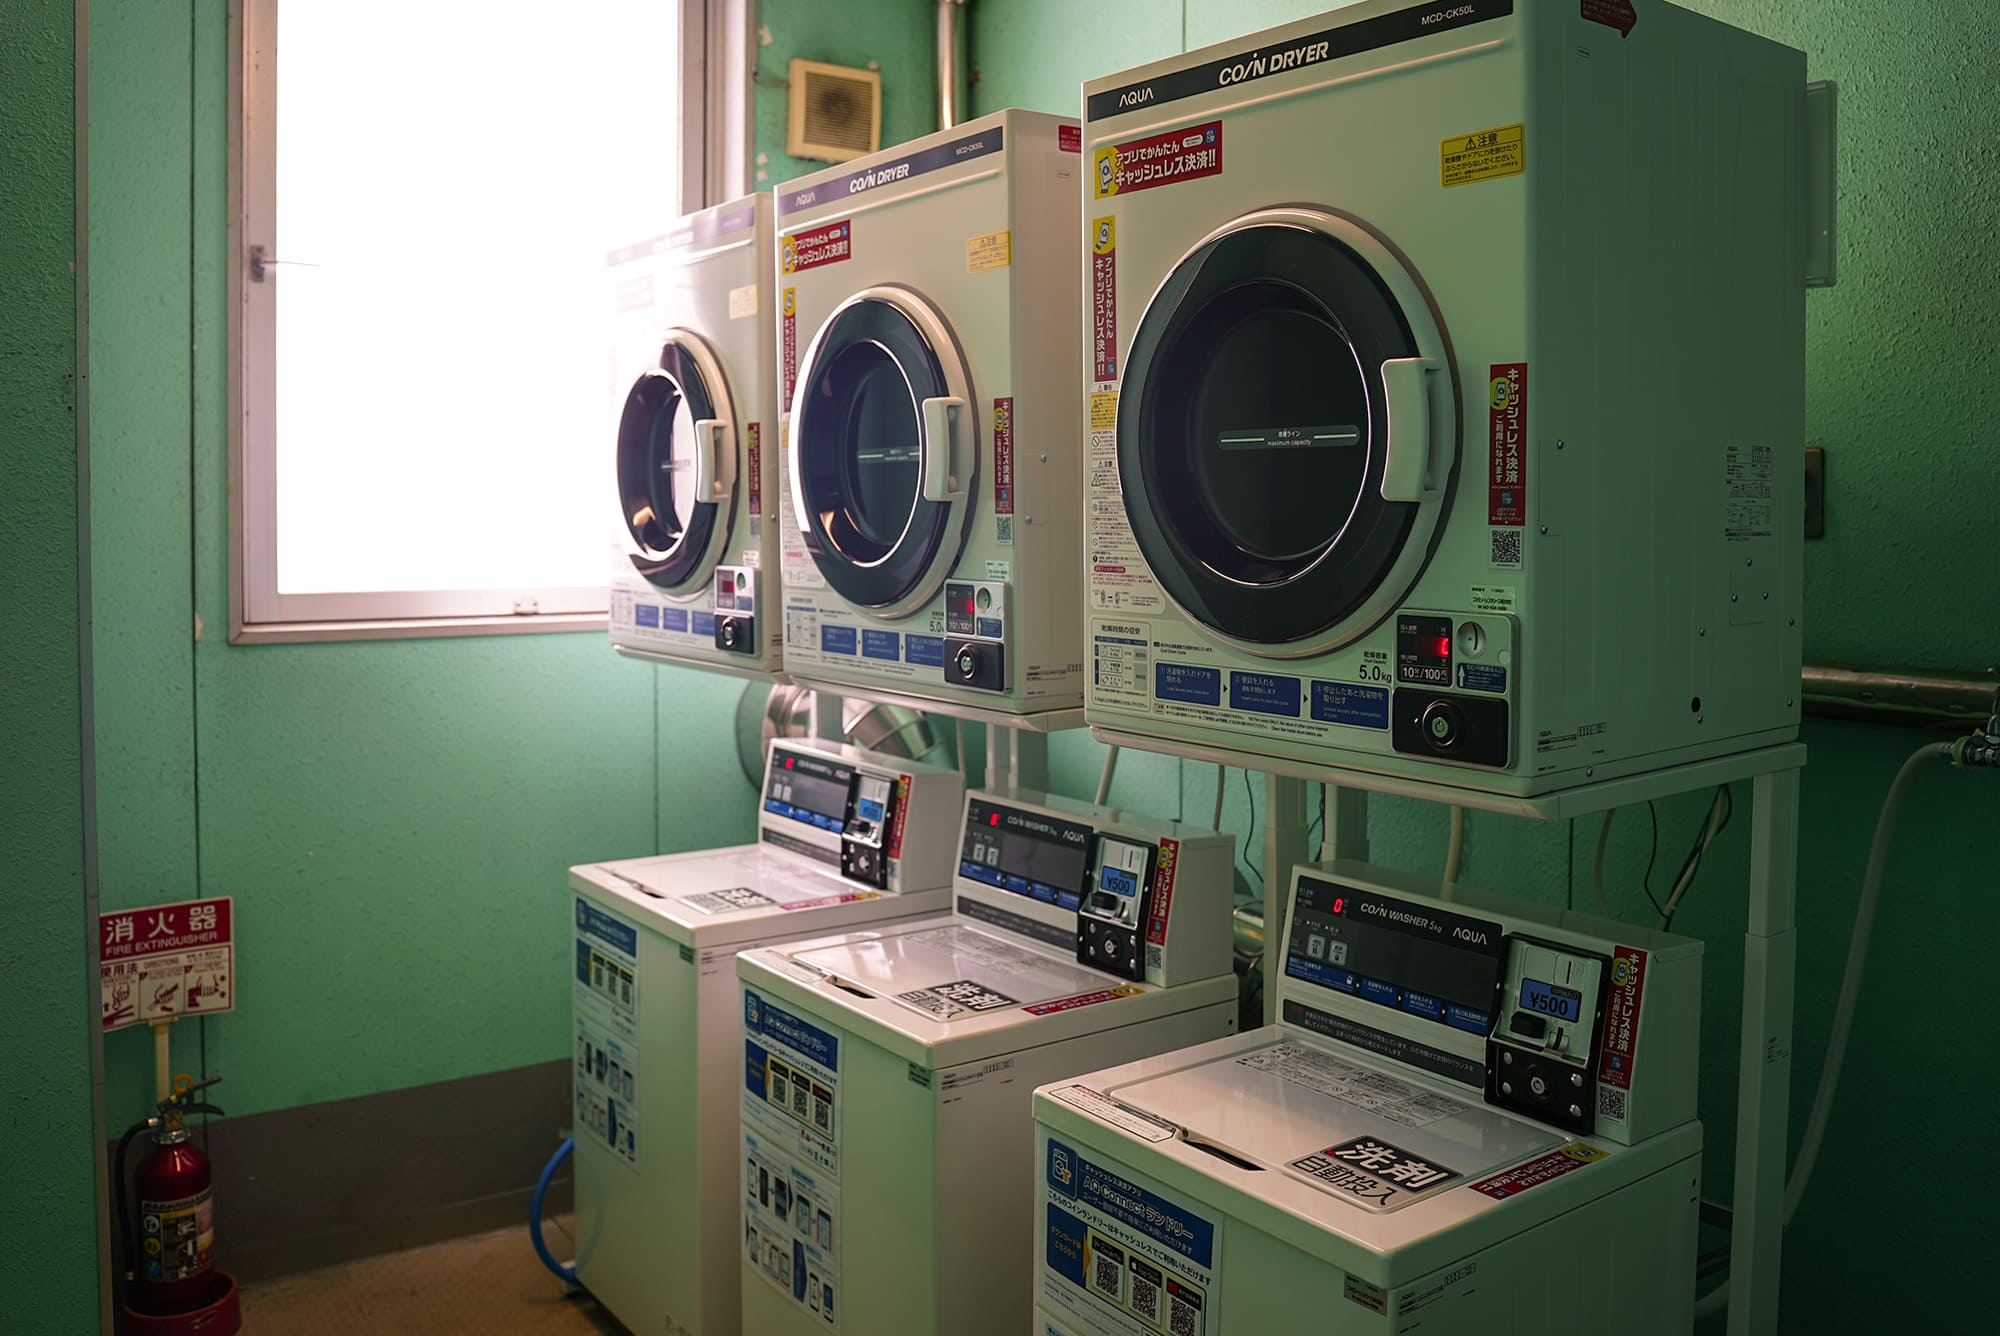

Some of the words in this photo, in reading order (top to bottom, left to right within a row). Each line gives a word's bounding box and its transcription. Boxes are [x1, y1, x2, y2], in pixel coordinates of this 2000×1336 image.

[1421, 4, 1475, 26] MCD-CK50L
[1269, 41, 1330, 72] DRYER
[1118, 87, 1154, 108] AQUA
[1115, 141, 1180, 167] アプリでかんたん
[1115, 149, 1216, 187] キャッシュレス決済!!
[877, 163, 910, 186] DRYER
[795, 191, 816, 206] AQUA
[1505, 367, 1520, 484] キャッシュレス決済
[1494, 414, 1504, 483] ご利用になれます
[1062, 829, 1085, 844] AQUA
[1107, 876, 1130, 894] ¥500
[1332, 897, 1344, 913] 0
[105, 904, 217, 945] 消火器
[1389, 909, 1428, 929] WASHER
[1452, 927, 1488, 946] AQUA
[105, 943, 132, 957] FIRE
[134, 931, 218, 952] EXTINGUISHER
[1530, 990, 1569, 1017] ¥500
[1616, 952, 1640, 1052] キャッシュレス決済
[1608, 989, 1623, 1048] ご利用になれます
[1291, 1155, 1398, 1206] 自動投入
[1333, 1141, 1450, 1191] 洗剤
[1146, 1206, 1194, 1240] ランドリー
